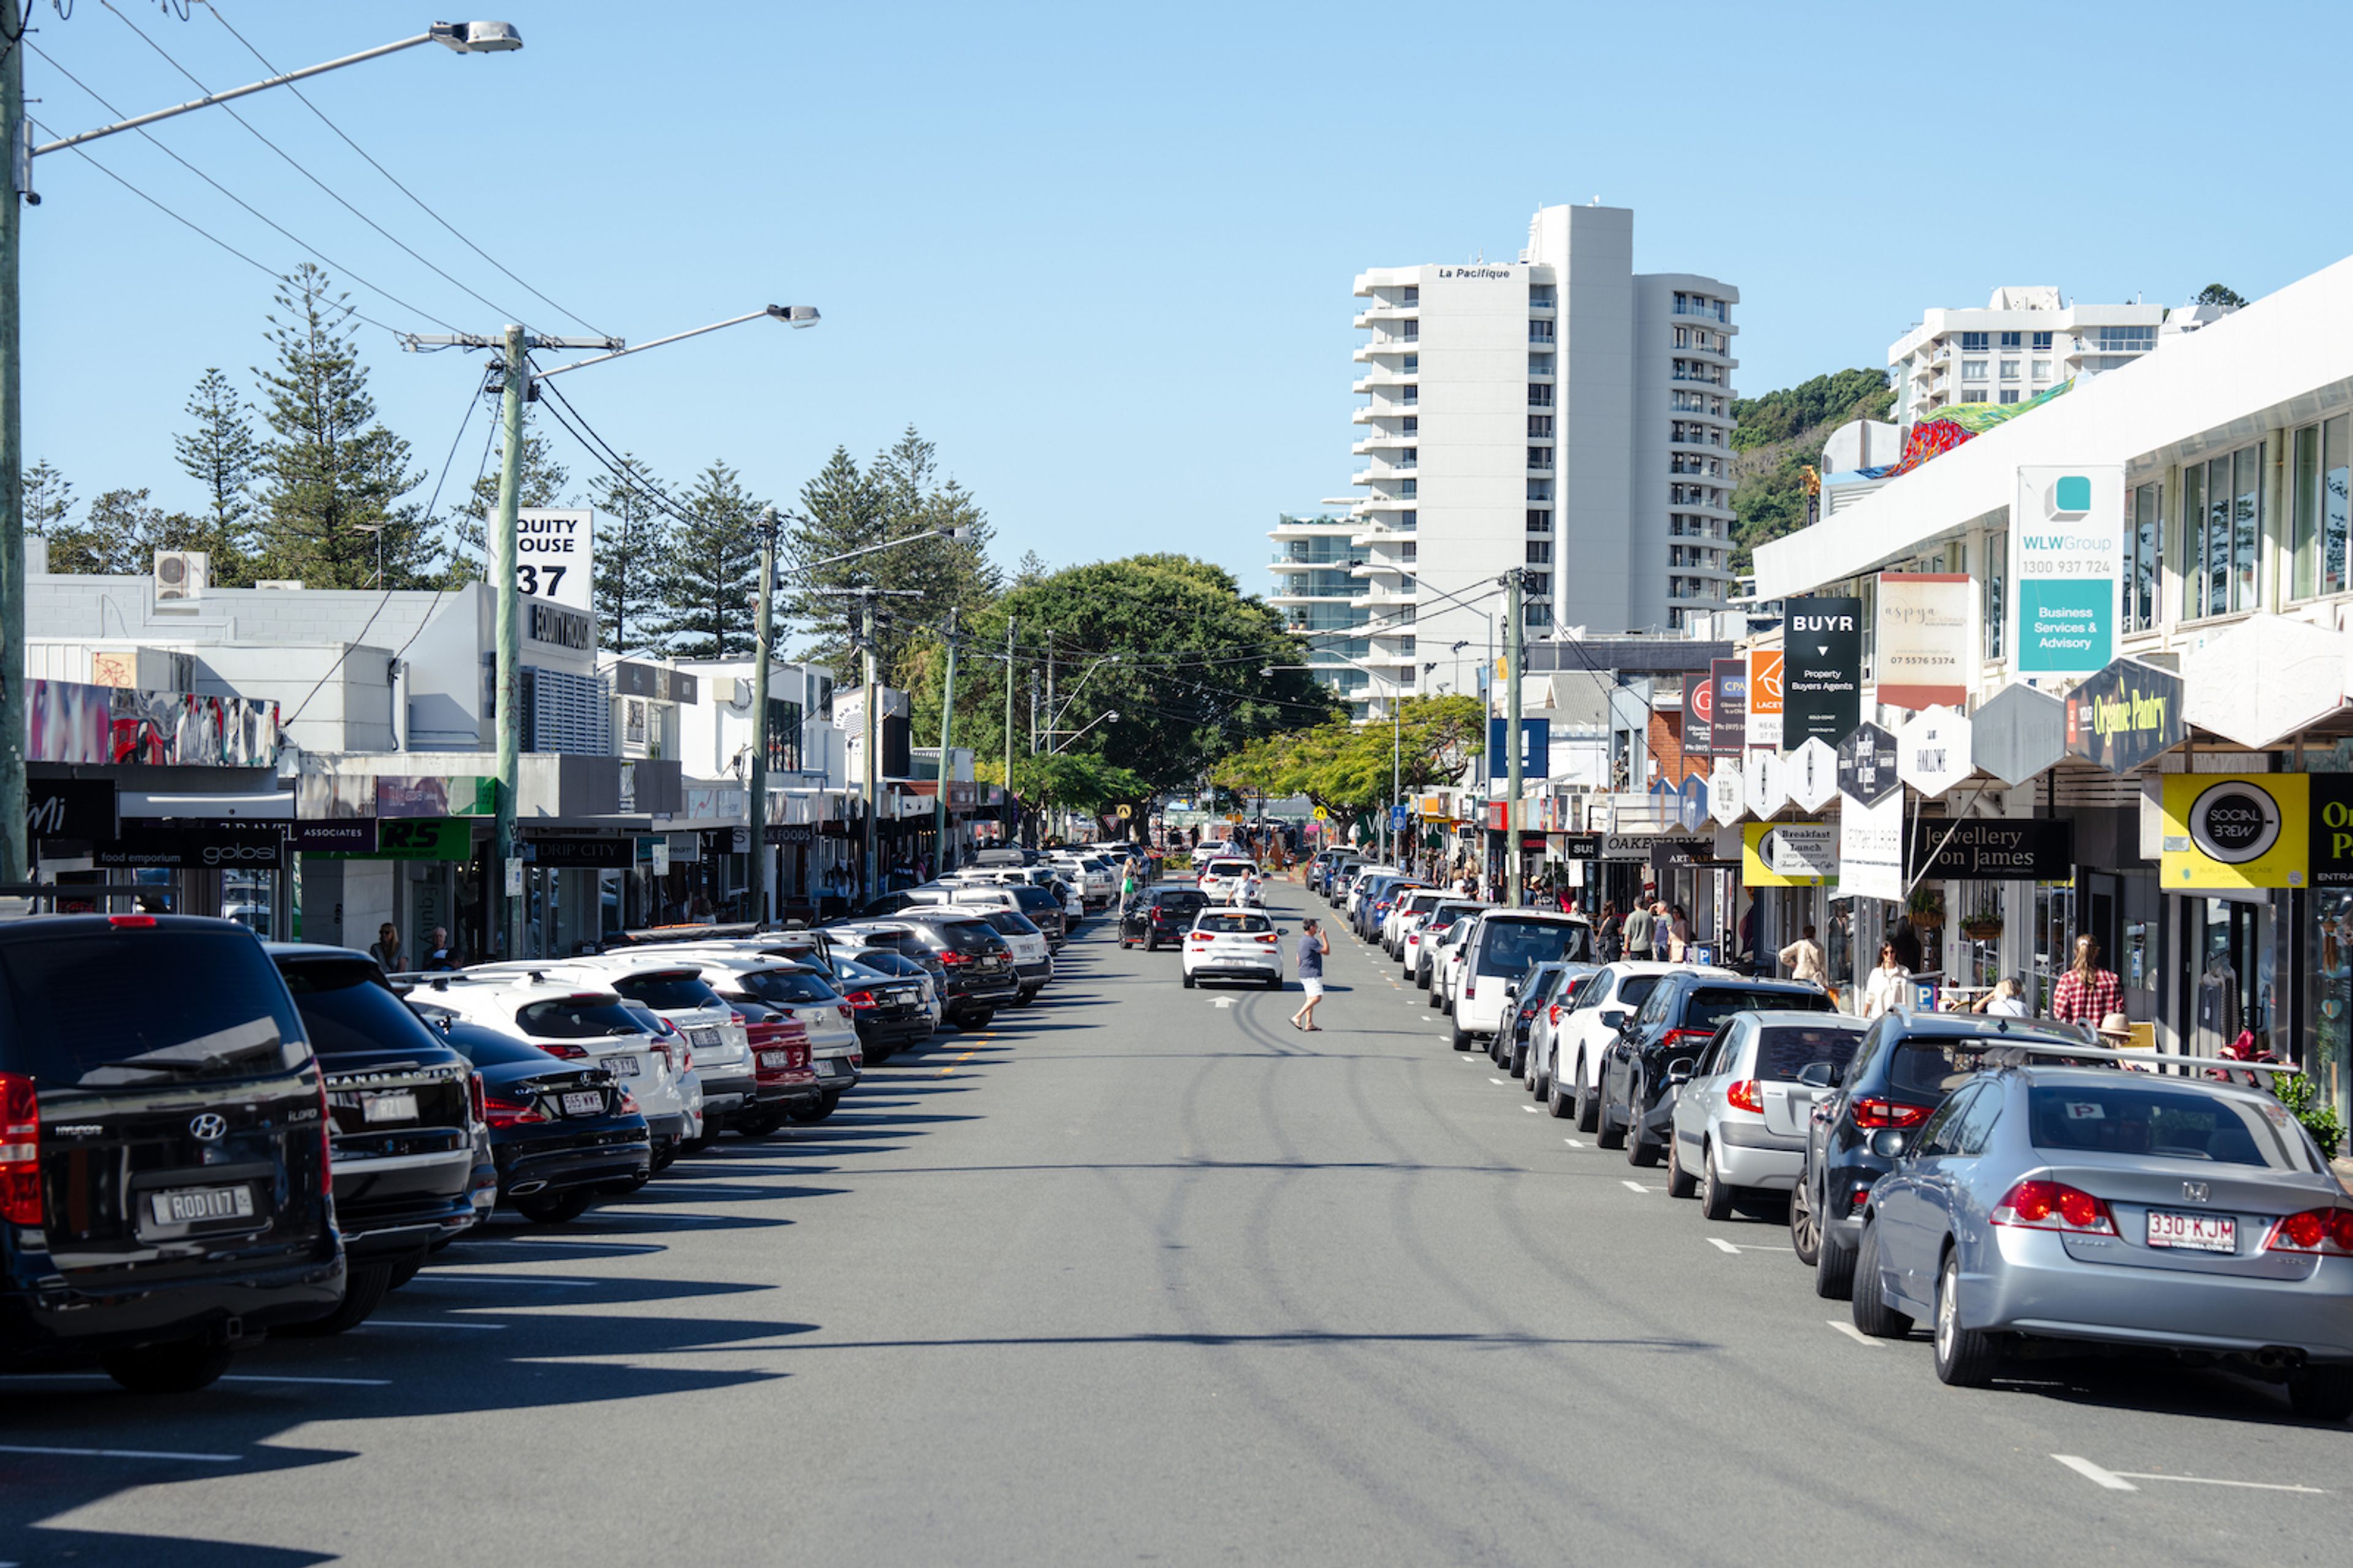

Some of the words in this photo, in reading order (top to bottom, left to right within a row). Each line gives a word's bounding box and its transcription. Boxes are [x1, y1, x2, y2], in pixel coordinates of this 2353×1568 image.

[1440, 269, 1452, 278] La
[1457, 268, 1510, 279] Pacifique
[517, 520, 577, 533] QUITY
[519, 539, 574, 552] OUSE
[2023, 536, 2112, 553] WLWGroup
[2023, 561, 2053, 573] 1300
[2058, 561, 2081, 573] 937
[2086, 561, 2110, 573] 724
[517, 565, 567, 596] 37
[1885, 607, 1936, 624] aspya
[2039, 607, 2093, 618] Business
[1793, 616, 1853, 631] BUYR
[2034, 622, 2085, 634] Services
[2088, 623, 2097, 633] &
[2039, 638, 2091, 651] Advisory
[1804, 670, 1841, 680] Property
[1791, 682, 1821, 691] Buyers
[1822, 682, 1854, 692] Agents
[2094, 676, 2131, 747] Organic
[2132, 689, 2167, 743] Pantry
[2210, 809, 2260, 821] SOCIAL
[304, 828, 363, 838] ASSOCIATES
[378, 822, 439, 847] RS
[777, 830, 811, 841] FOODS
[2215, 825, 2254, 837] BREW
[1924, 825, 2023, 852] Jewellery
[539, 843, 576, 857] DRIP
[580, 843, 618, 857] CITY
[1790, 843, 1822, 852] Lunch
[2332, 832, 2353, 859] P
[102, 852, 126, 863] food
[127, 852, 181, 865] emporium
[203, 842, 276, 865] golosi
[1939, 850, 1966, 865] on
[1972, 846, 2034, 873] James
[1919, 987, 1932, 1003] P
[325, 1075, 391, 1086] RANGE
[401, 1069, 451, 1083] ROVER
